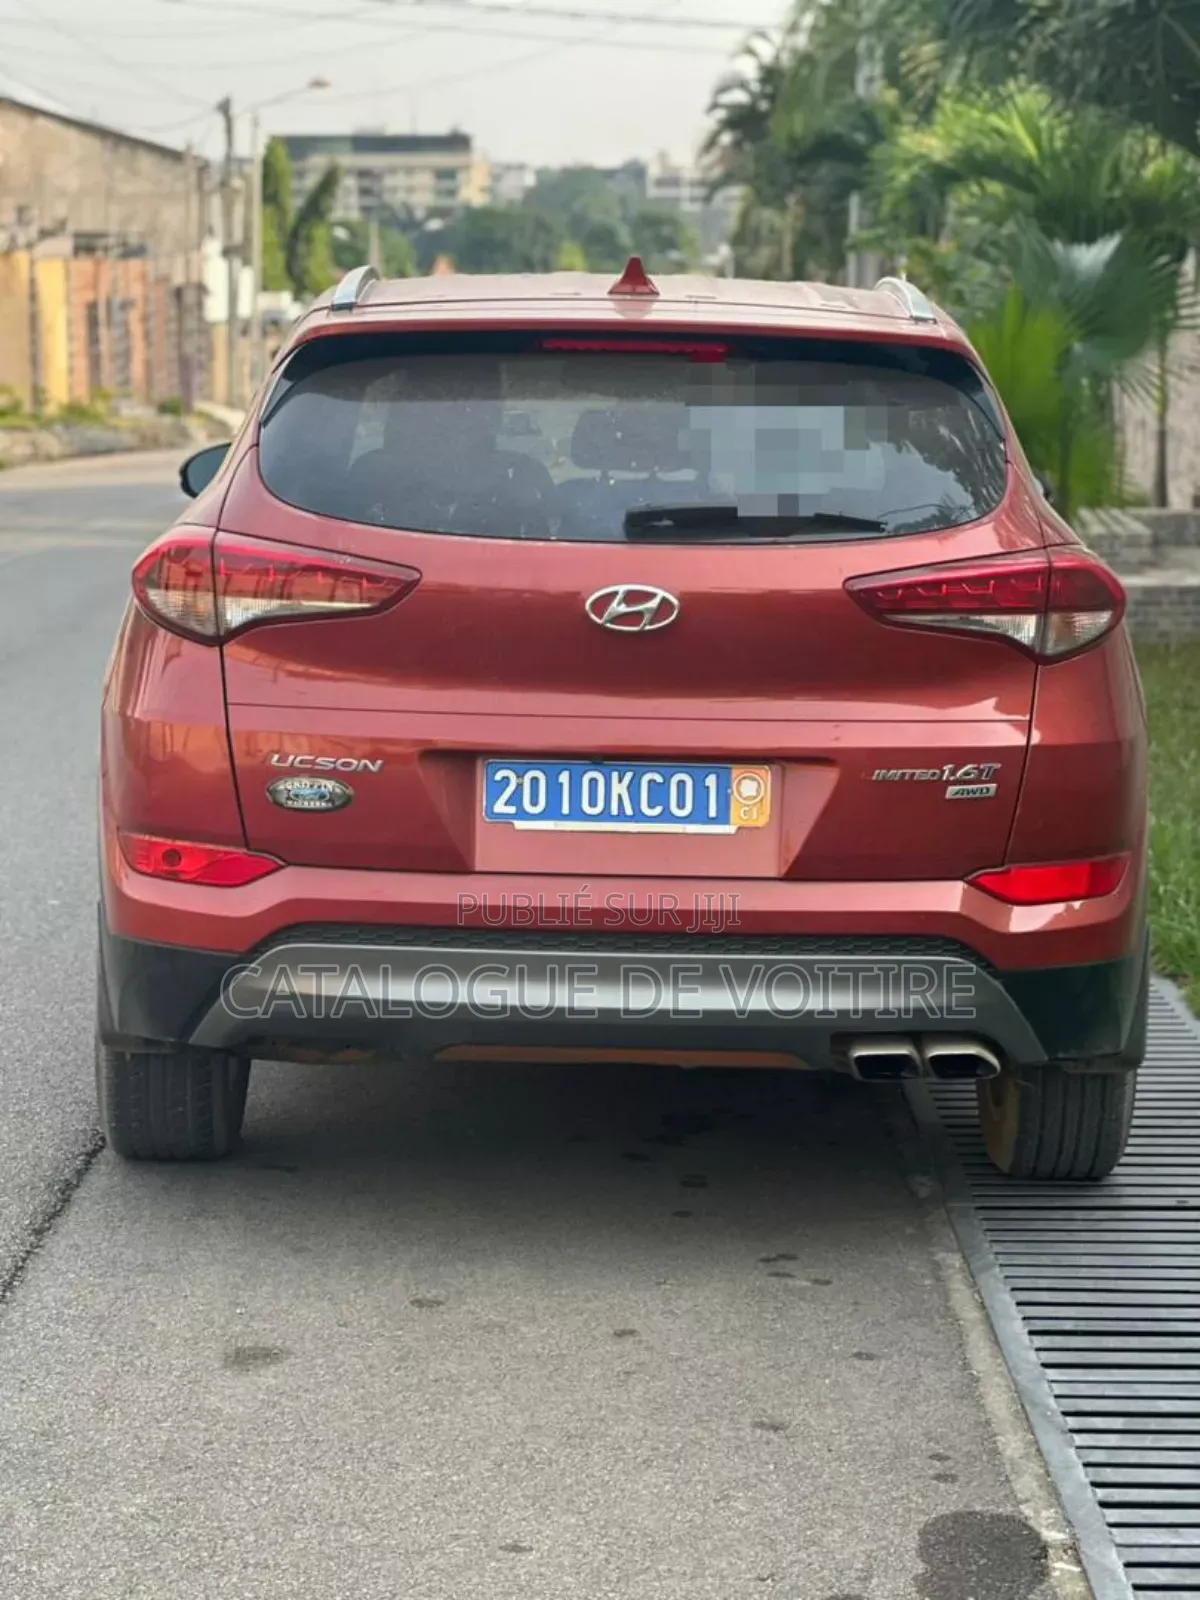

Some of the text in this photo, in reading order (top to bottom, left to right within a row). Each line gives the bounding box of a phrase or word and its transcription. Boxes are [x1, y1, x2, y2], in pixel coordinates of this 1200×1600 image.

[271, 754, 383, 773] UCSON
[492, 768, 719, 819] 2010KC01
[952, 786, 990, 797] AWD
